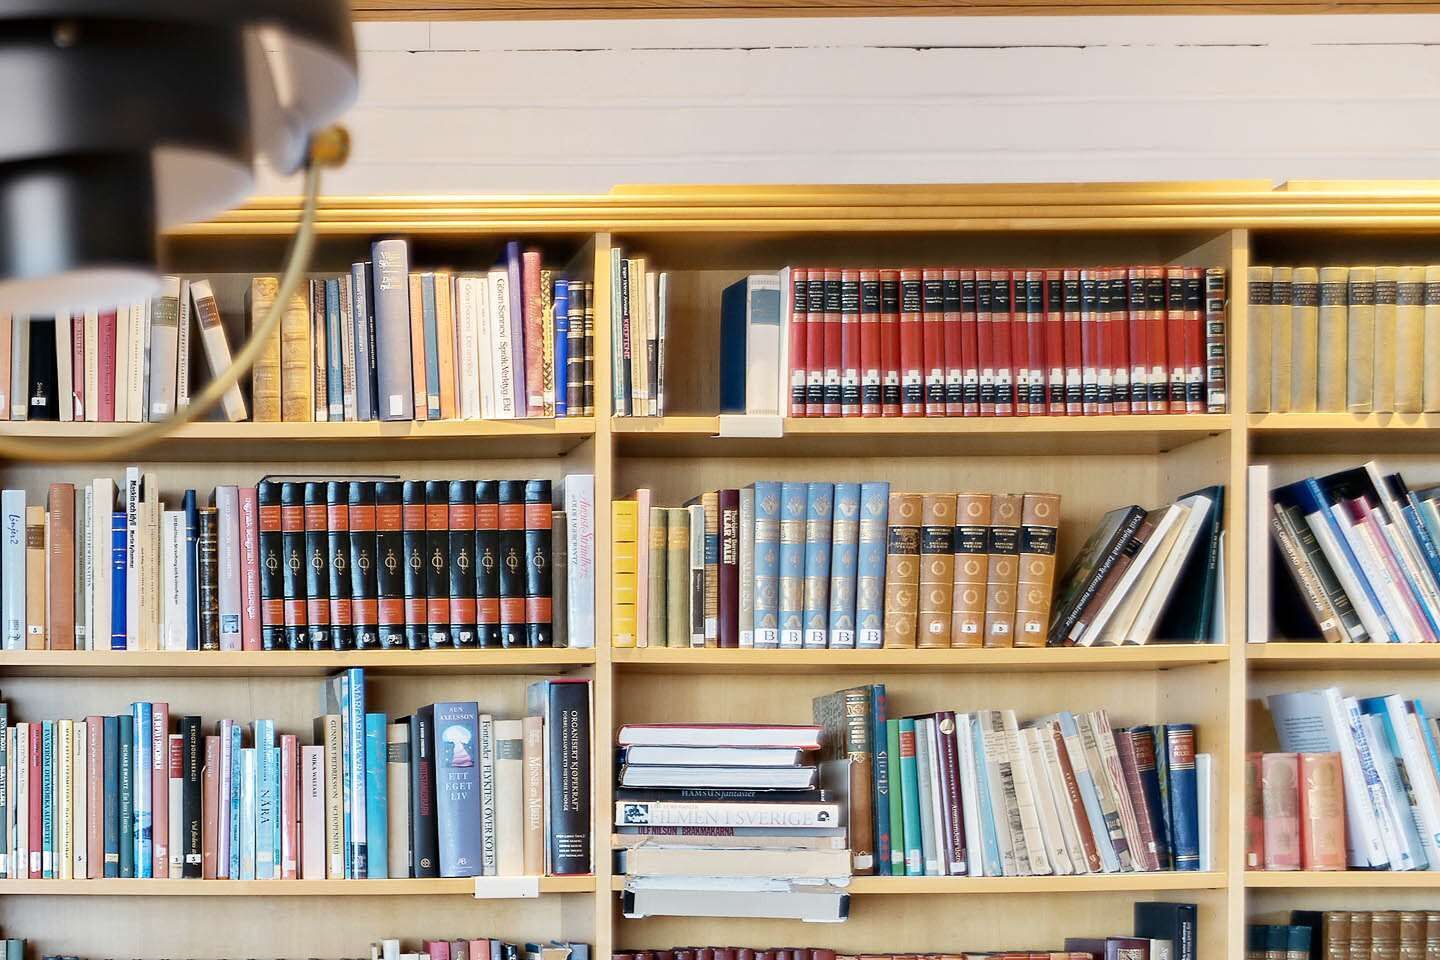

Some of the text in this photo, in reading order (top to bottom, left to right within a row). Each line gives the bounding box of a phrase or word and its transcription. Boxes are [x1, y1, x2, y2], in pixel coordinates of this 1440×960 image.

[130, 480, 138, 502] Maskin
[723, 510, 732, 536] KLAR
[1272, 517, 1282, 531] TOR
[764, 630, 775, 640] B
[789, 632, 798, 642] B
[812, 632, 823, 642] B
[838, 632, 850, 642] B
[868, 632, 878, 642] B
[329, 720, 338, 751] GUNNAR
[481, 720, 490, 760] Fontander
[44, 745, 52, 766] STRÖM
[570, 710, 579, 812] ORGANISERT KJØPEKRAFT
[448, 772, 468, 780] ETT
[446, 782, 472, 790] EGET
[482, 764, 492, 806] FLYKTEN
[450, 792, 468, 800] LIV
[260, 789, 272, 824] NÄRA
[484, 808, 495, 835] ÖVER
[648, 811, 719, 825] FILMEN
[736, 810, 812, 826] SVERIGE
[638, 826, 677, 836] ULF NILSON
